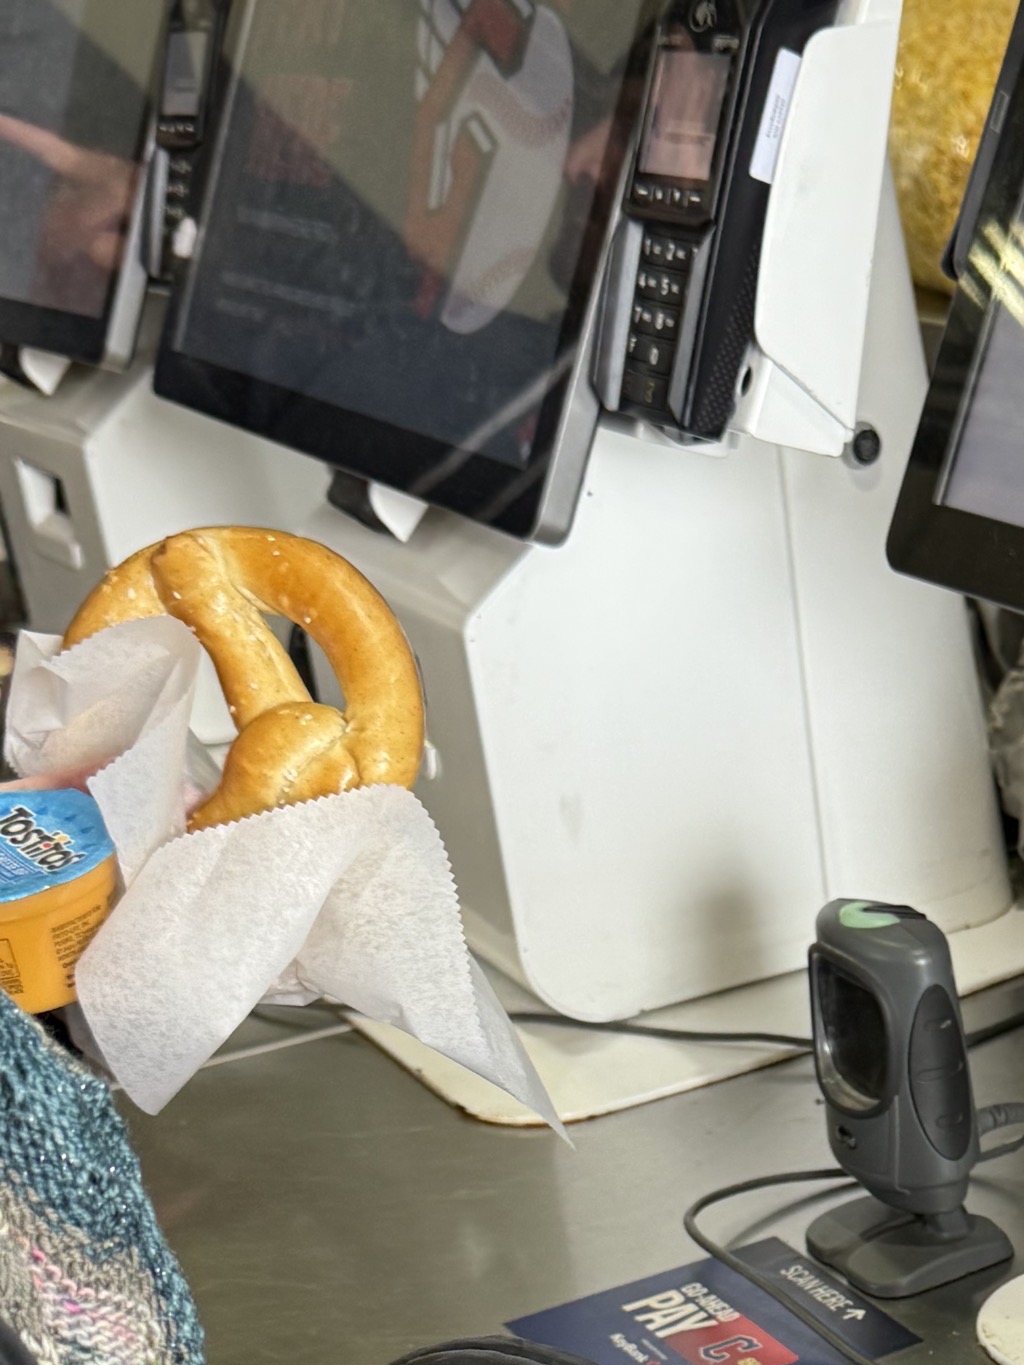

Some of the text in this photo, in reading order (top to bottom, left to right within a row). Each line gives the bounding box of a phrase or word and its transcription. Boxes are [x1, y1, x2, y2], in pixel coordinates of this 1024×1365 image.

[780, 1265, 853, 1311] SCAN HERE
[622, 1289, 719, 1338] PAY
[699, 1334, 763, 1363] C
